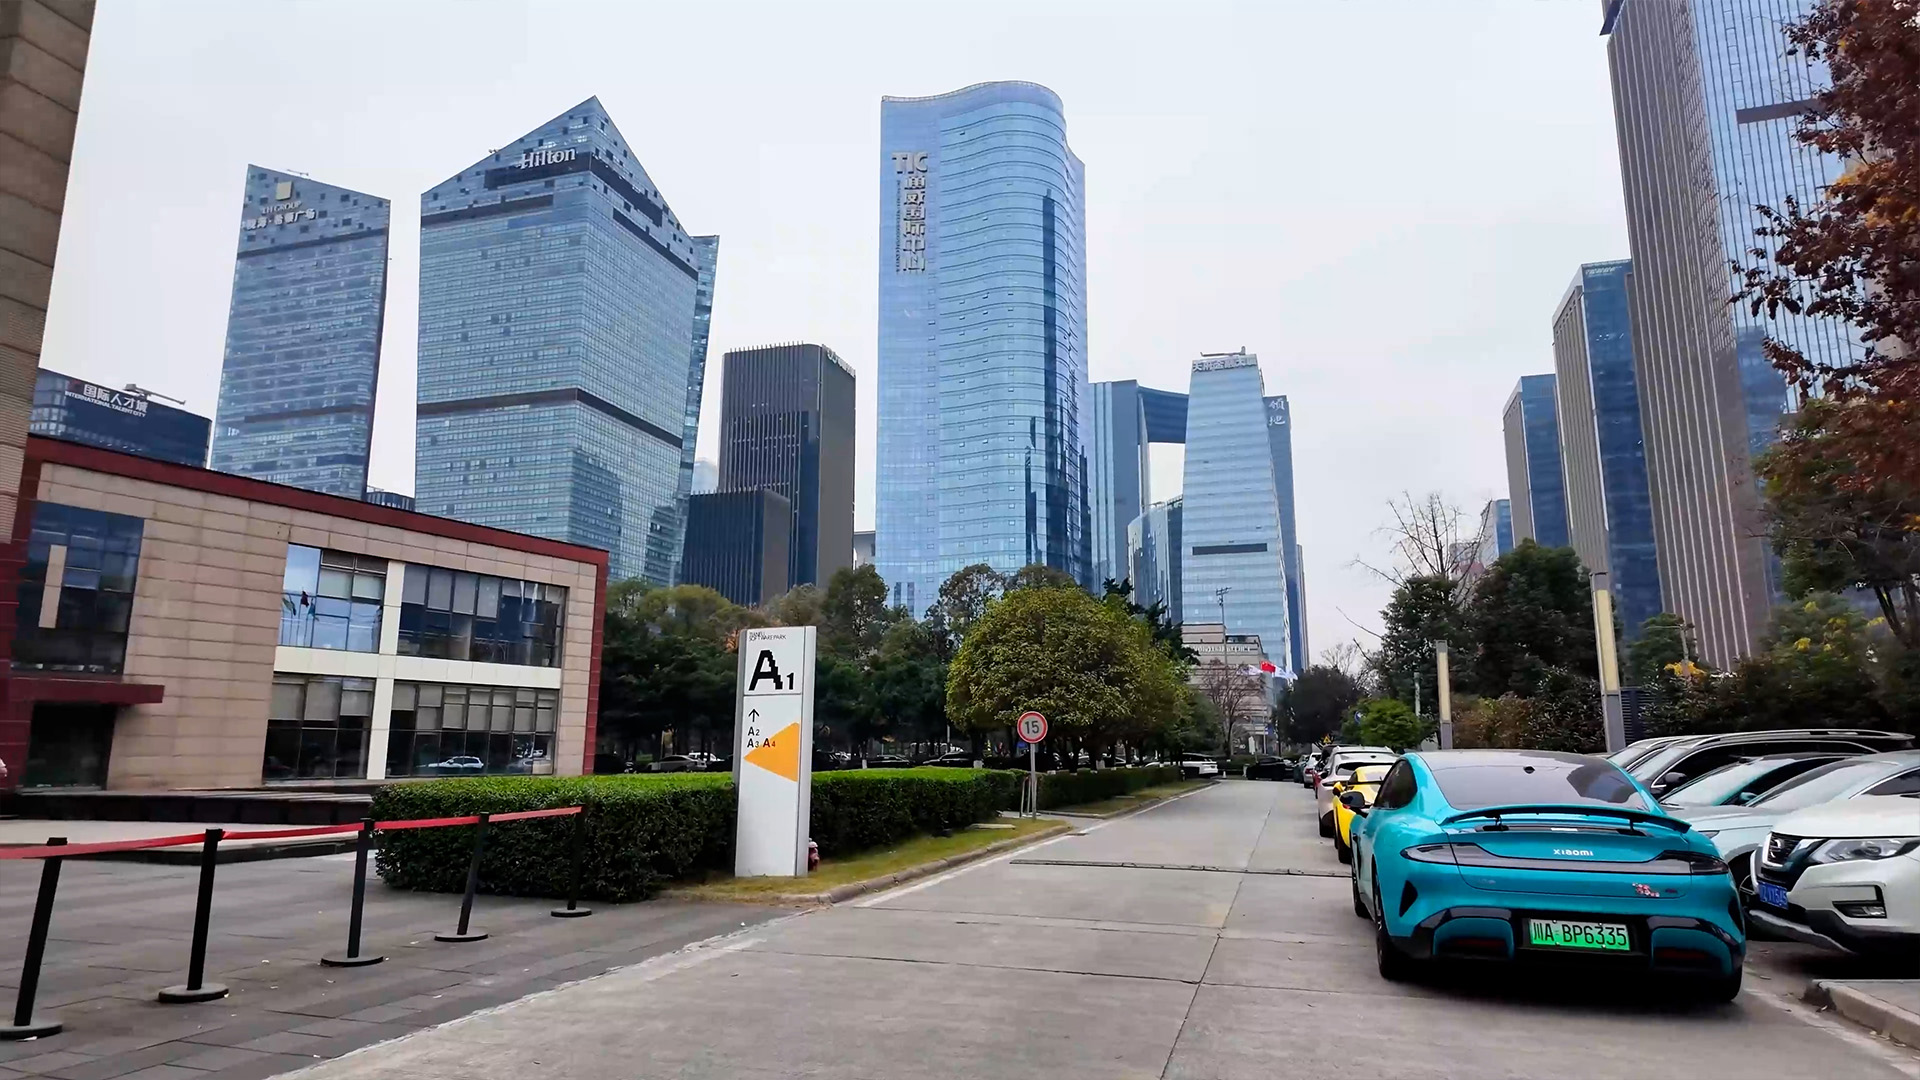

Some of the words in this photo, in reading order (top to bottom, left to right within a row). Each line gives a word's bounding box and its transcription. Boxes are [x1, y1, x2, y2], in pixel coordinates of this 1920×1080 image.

[516, 148, 576, 169] Hilton
[892, 152, 929, 174] TIC
[64, 390, 111, 409] INTERNATIONAL
[112, 403, 133, 415] TALENT
[83, 384, 148, 412] 国际人才城
[747, 726, 760, 736] A2
[1025, 721, 1040, 734] 15
